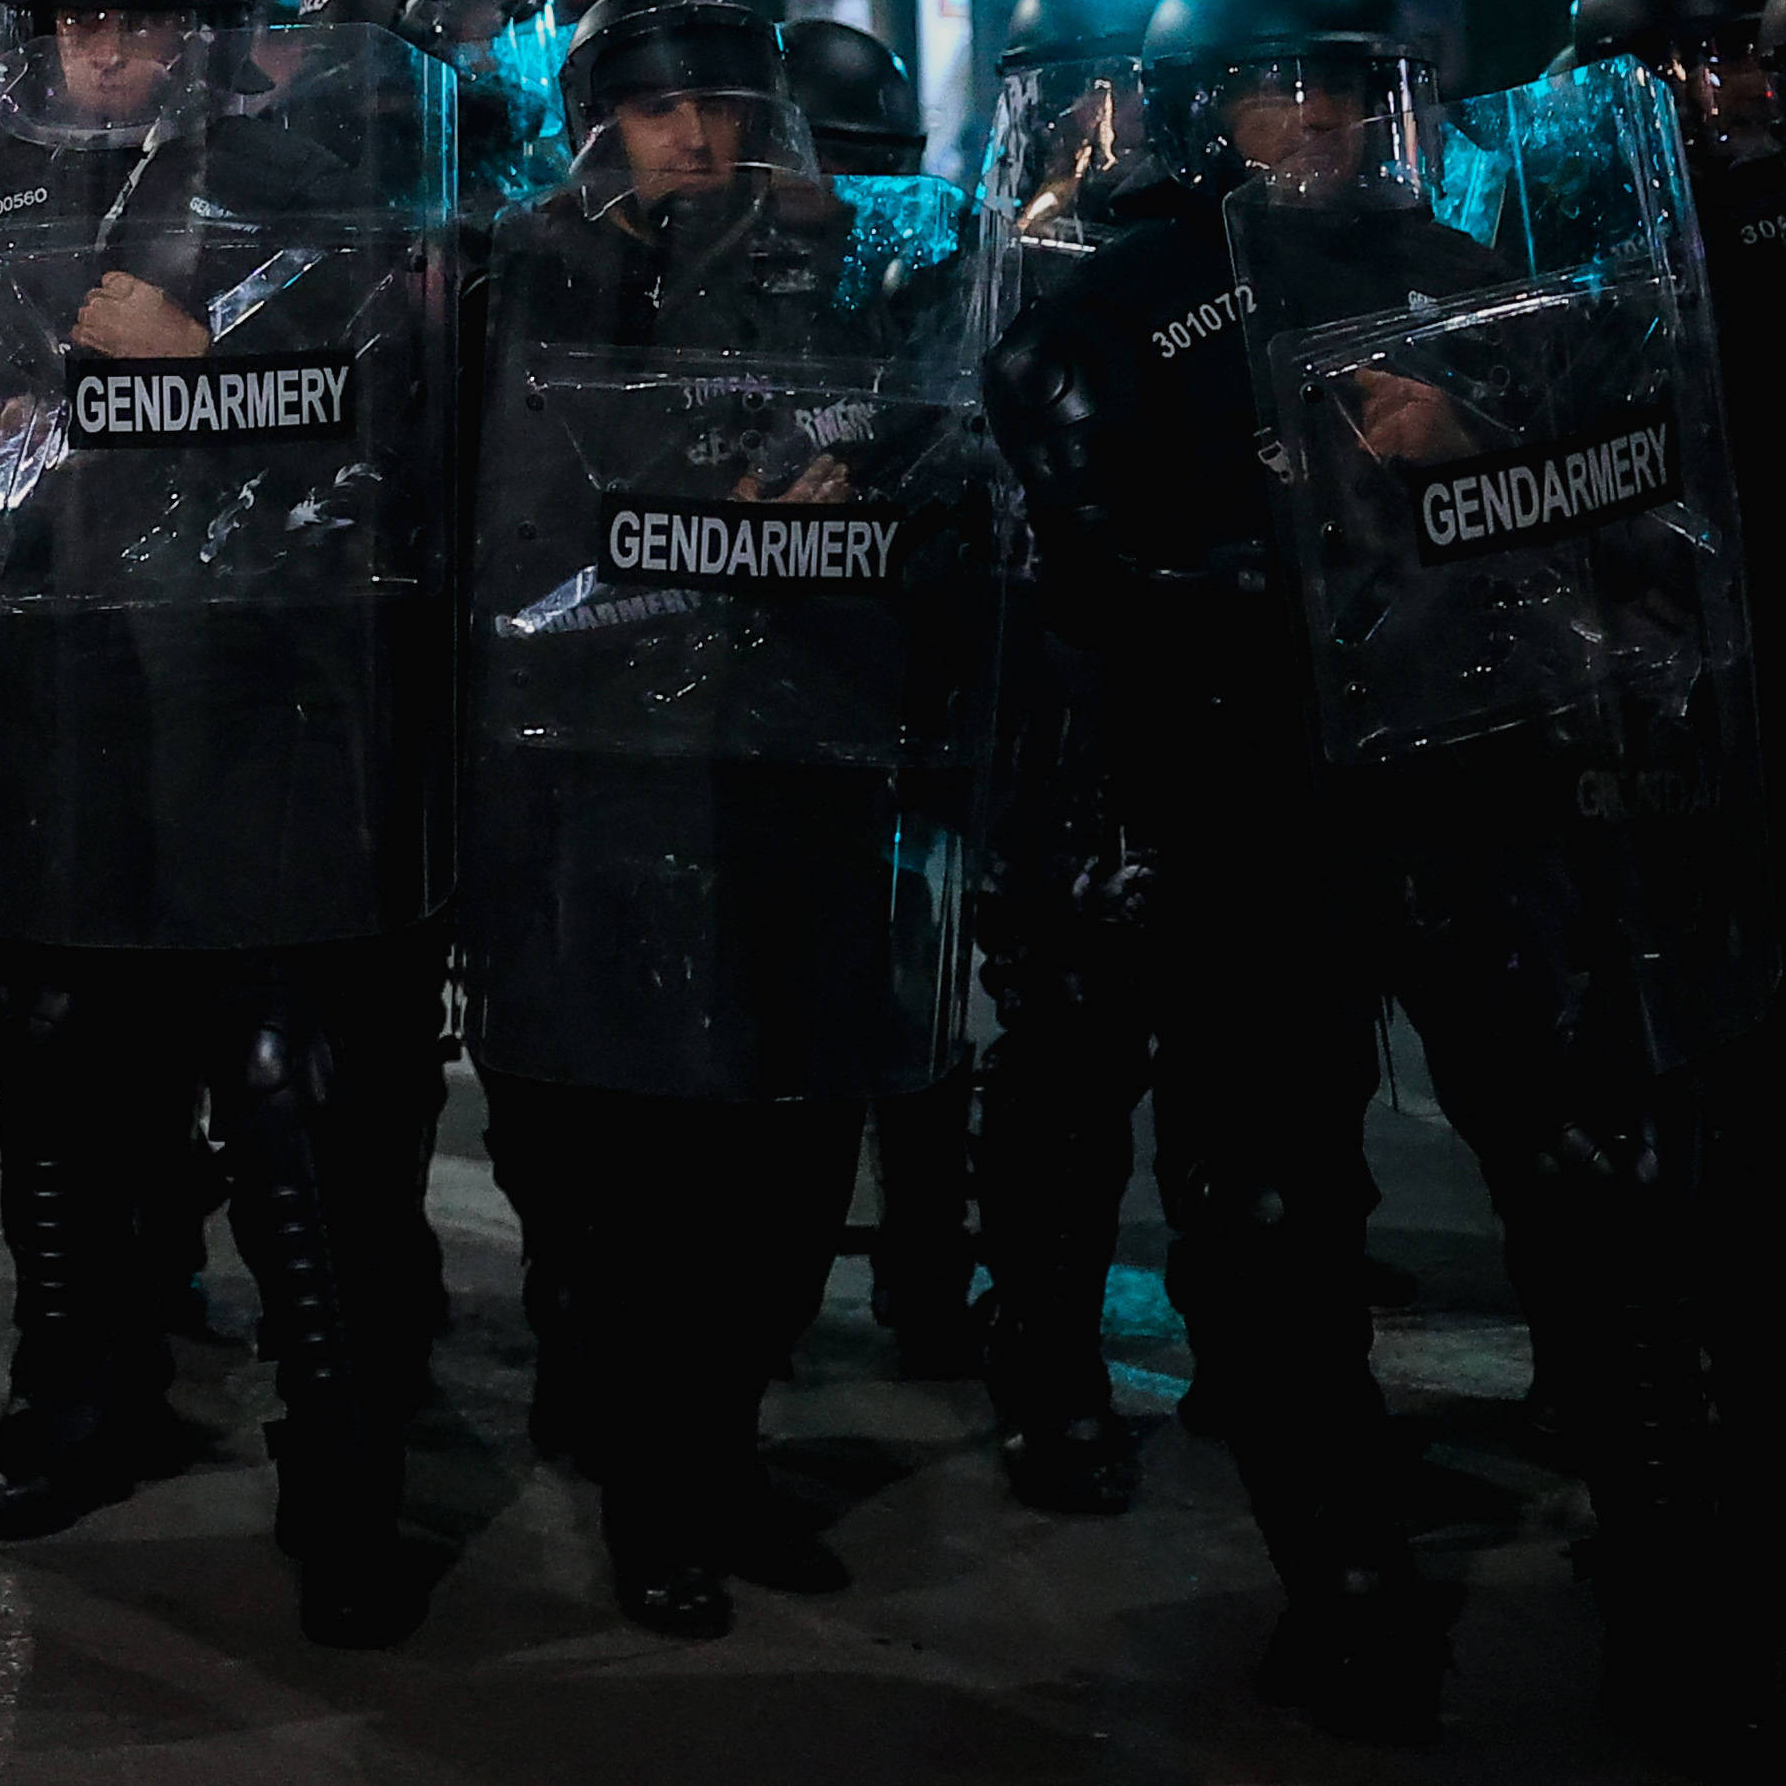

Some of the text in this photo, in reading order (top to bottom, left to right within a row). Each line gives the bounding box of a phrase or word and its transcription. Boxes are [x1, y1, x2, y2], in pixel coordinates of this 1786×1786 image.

[1151, 284, 1257, 359] 301072
[77, 367, 349, 433] GENDARMERY
[1424, 424, 1667, 546] GENDARMERY
[610, 510, 898, 578] GENDARMERY
